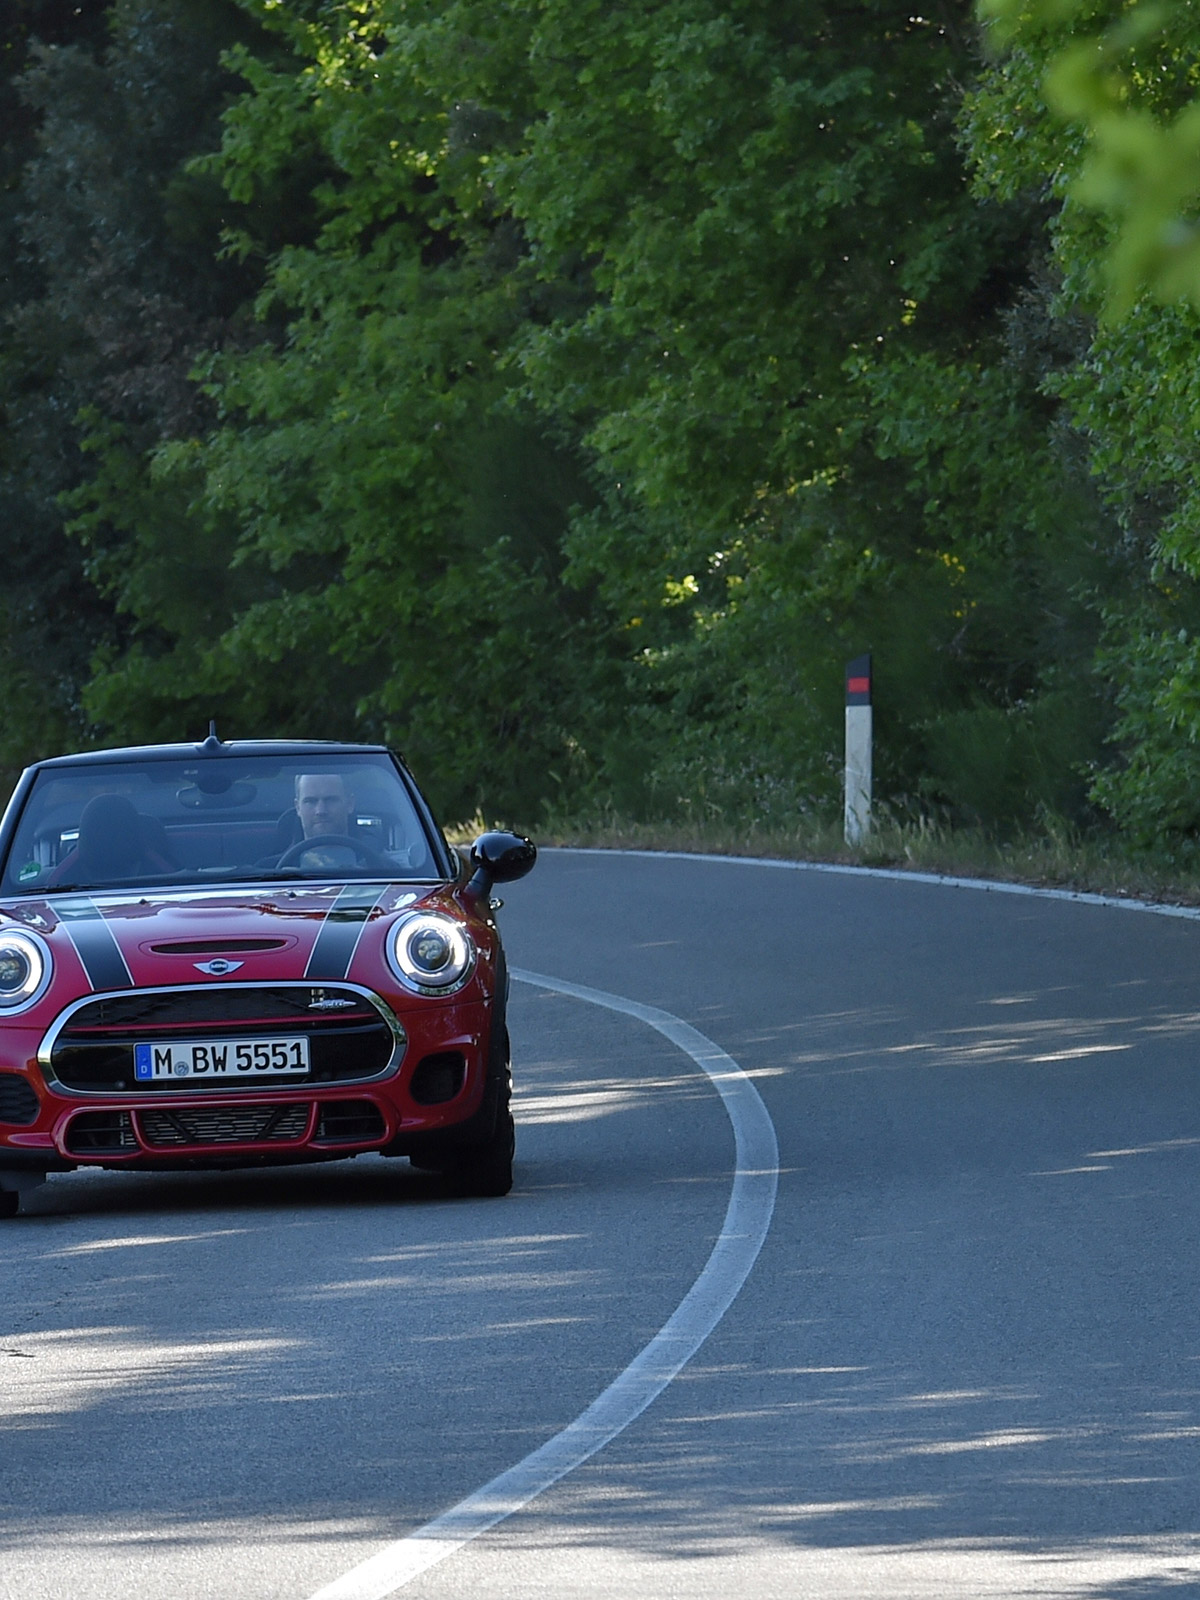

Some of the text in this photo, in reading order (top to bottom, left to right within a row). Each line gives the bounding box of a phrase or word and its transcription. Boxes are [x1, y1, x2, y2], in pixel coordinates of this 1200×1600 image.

[154, 1042, 306, 1075] M BW 5551
[141, 1065, 148, 1074] D
